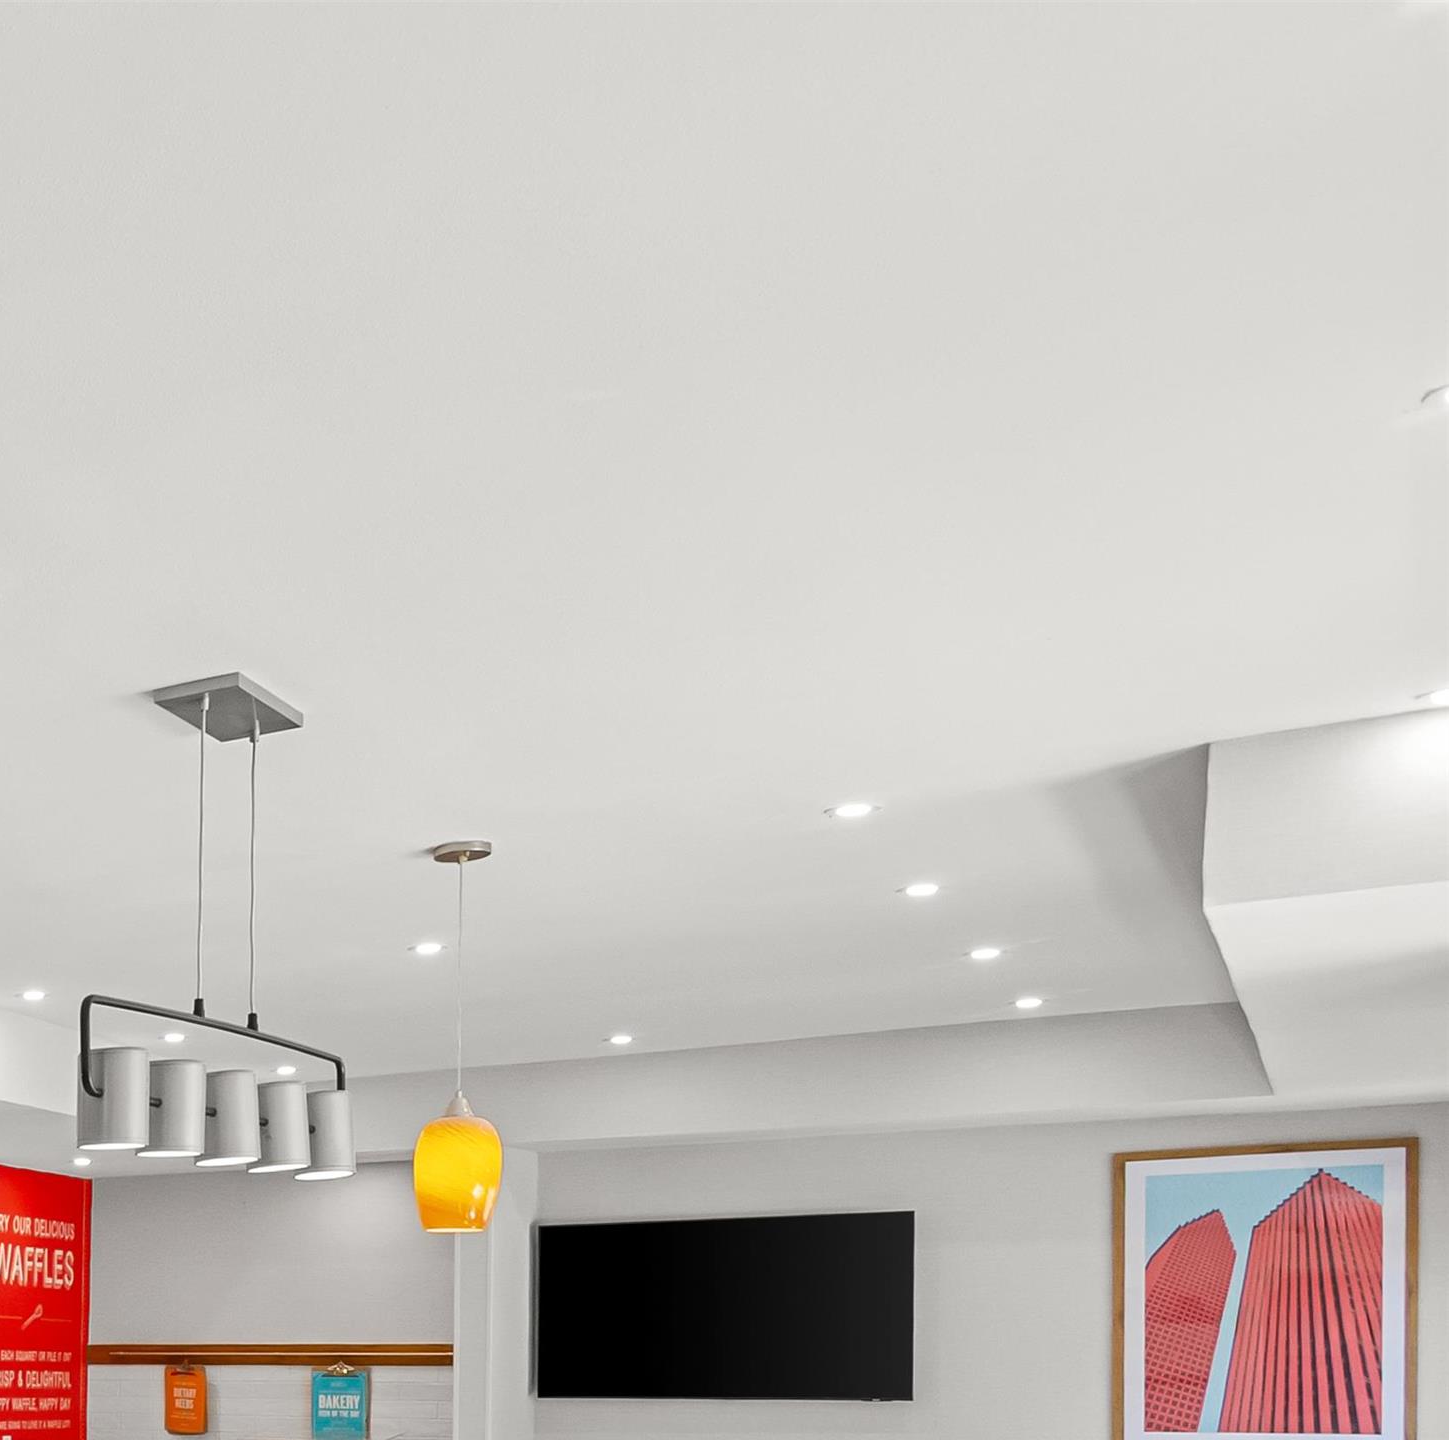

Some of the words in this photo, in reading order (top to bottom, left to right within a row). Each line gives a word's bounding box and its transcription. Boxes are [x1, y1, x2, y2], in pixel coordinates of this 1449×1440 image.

[12, 1215, 31, 1236] OUR
[34, 1217, 75, 1240] DELICIOUS
[0, 1350, 14, 1360] EACH
[17, 1370, 23, 1388] &
[25, 1370, 72, 1389] DELIGHTFUL
[39, 1398, 58, 1411] HAPPY
[318, 1394, 360, 1409] BAKERY
